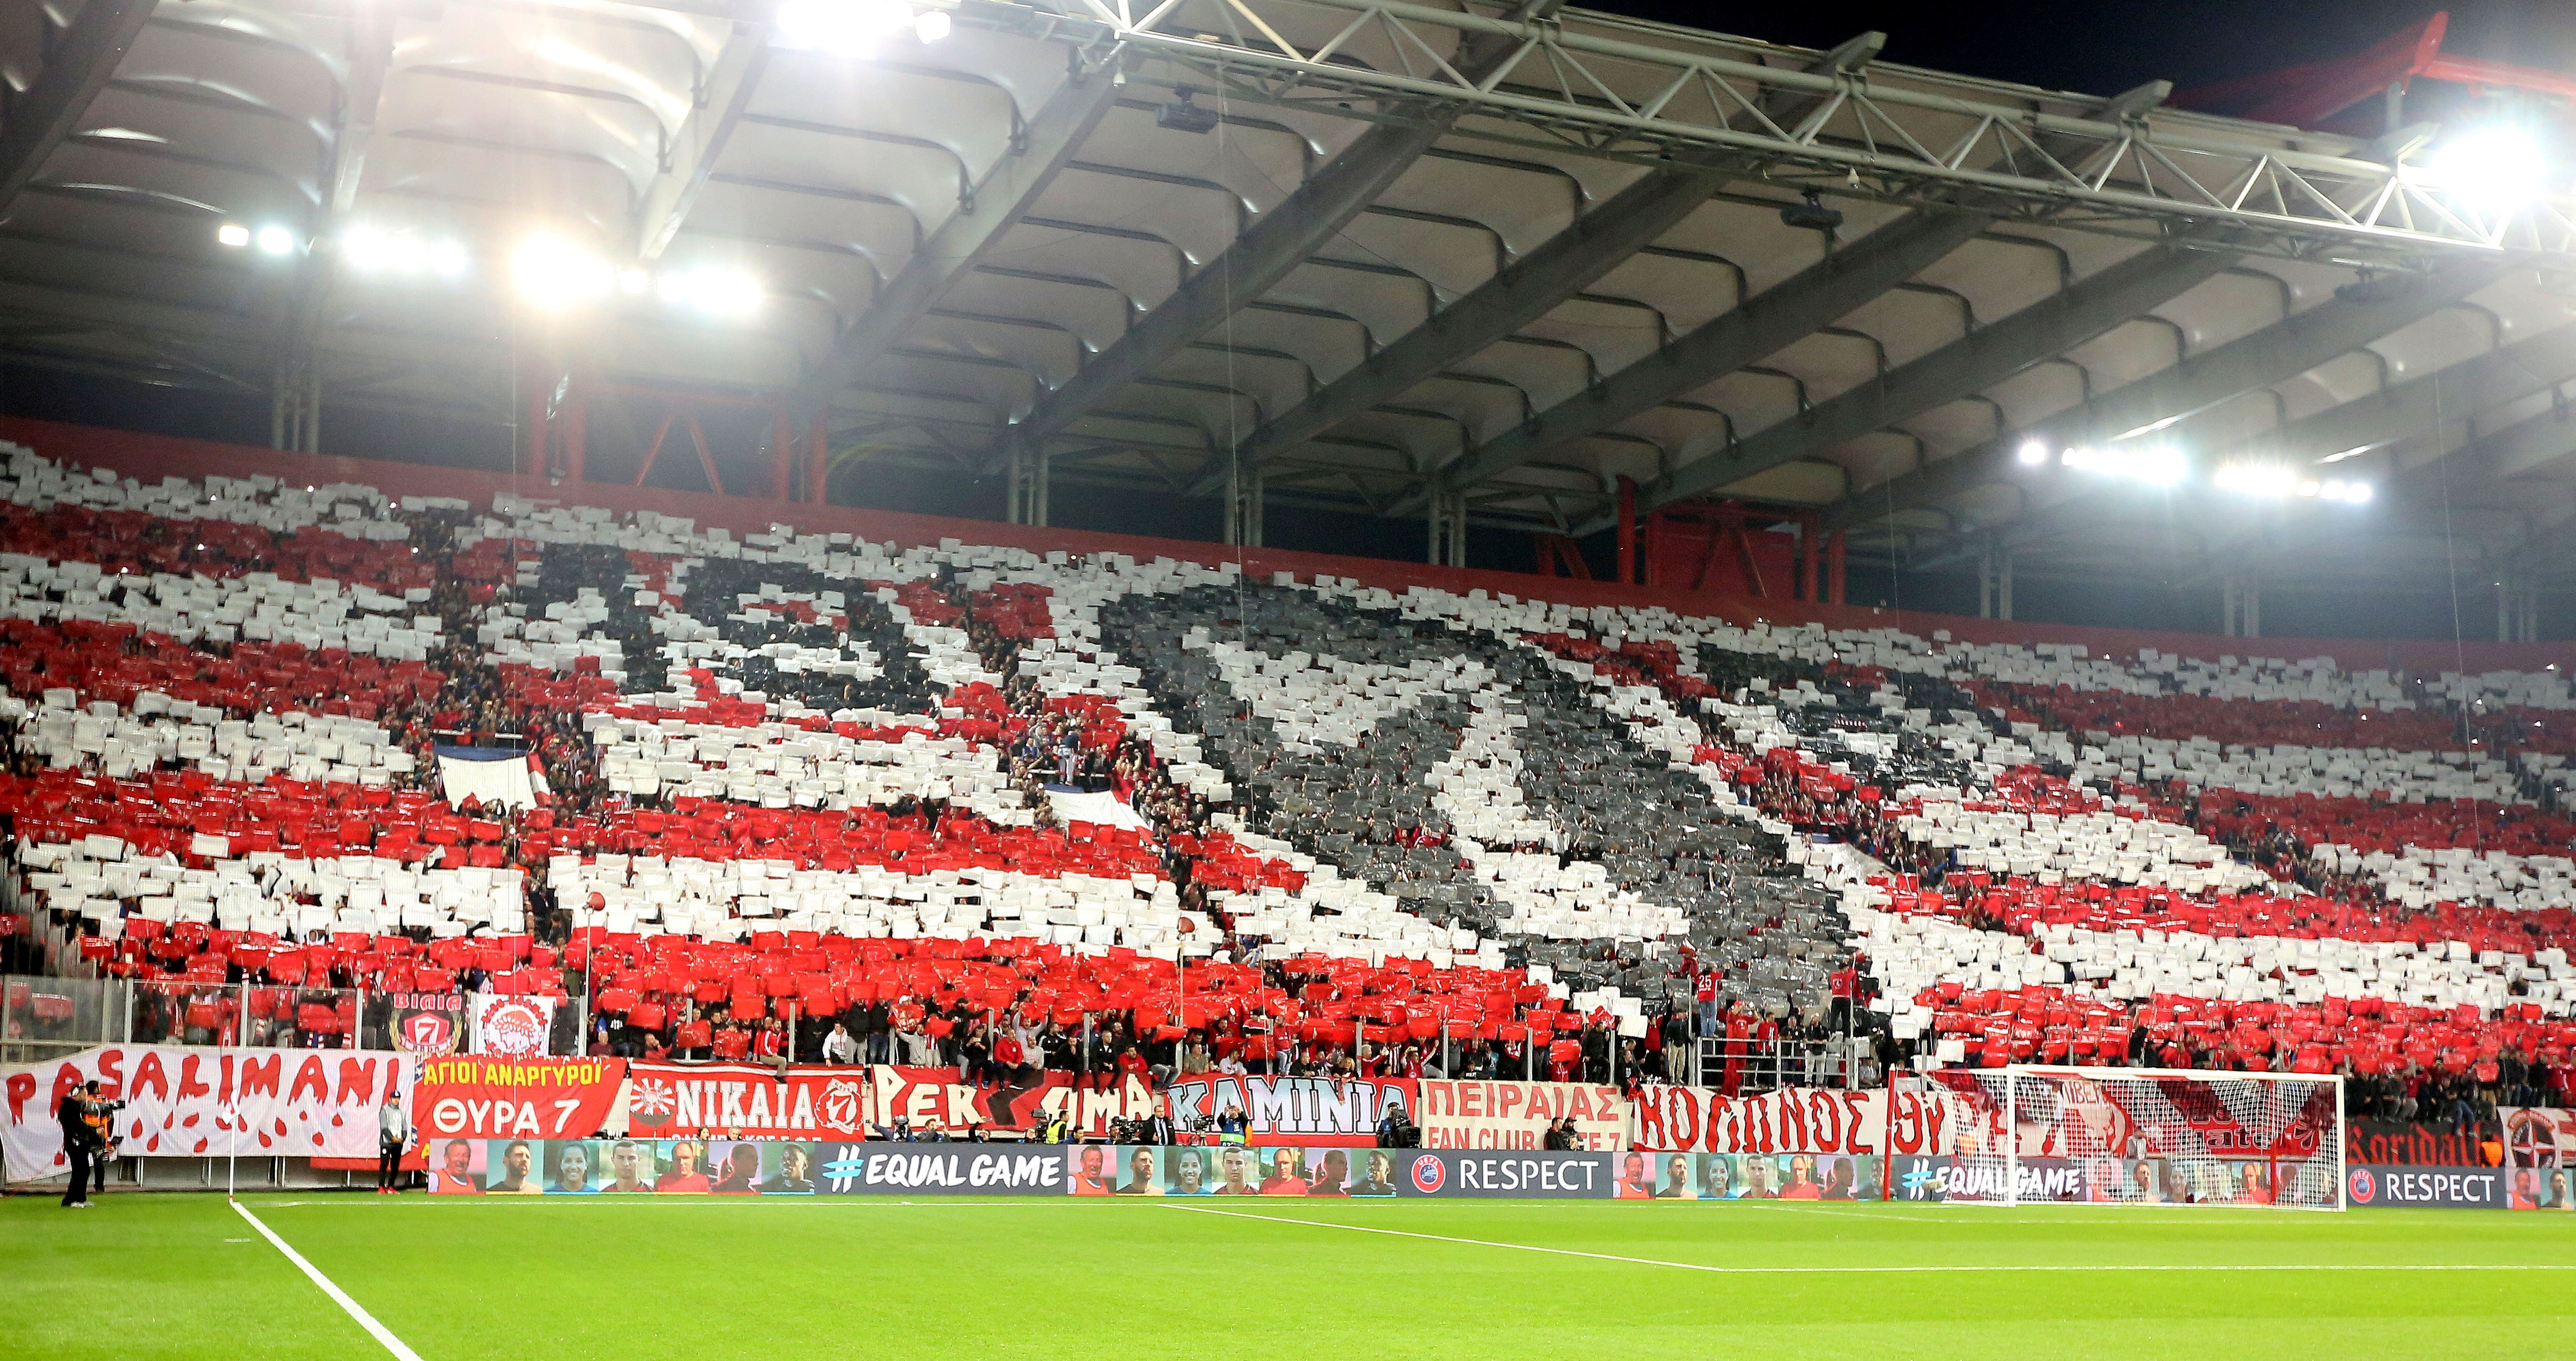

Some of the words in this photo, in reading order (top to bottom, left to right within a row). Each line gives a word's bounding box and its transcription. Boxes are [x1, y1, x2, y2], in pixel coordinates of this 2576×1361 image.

[1699, 975, 1712, 988] 25
[418, 1022, 436, 1042] 7
[7, 1050, 399, 1126] PASALIMANI
[1426, 1081, 1619, 1121] ΠΕΙΡΑΙΑΣ
[433, 1097, 540, 1135] ΘΥΡΑ
[554, 1098, 581, 1133] 7
[1428, 1127, 1470, 1150] FAN
[1609, 1132, 1620, 1151] 7
[1418, 1157, 1439, 1166] UEFA
[1460, 1159, 1599, 1191] RESPECT
[2386, 1172, 2495, 1202] RESPECT
